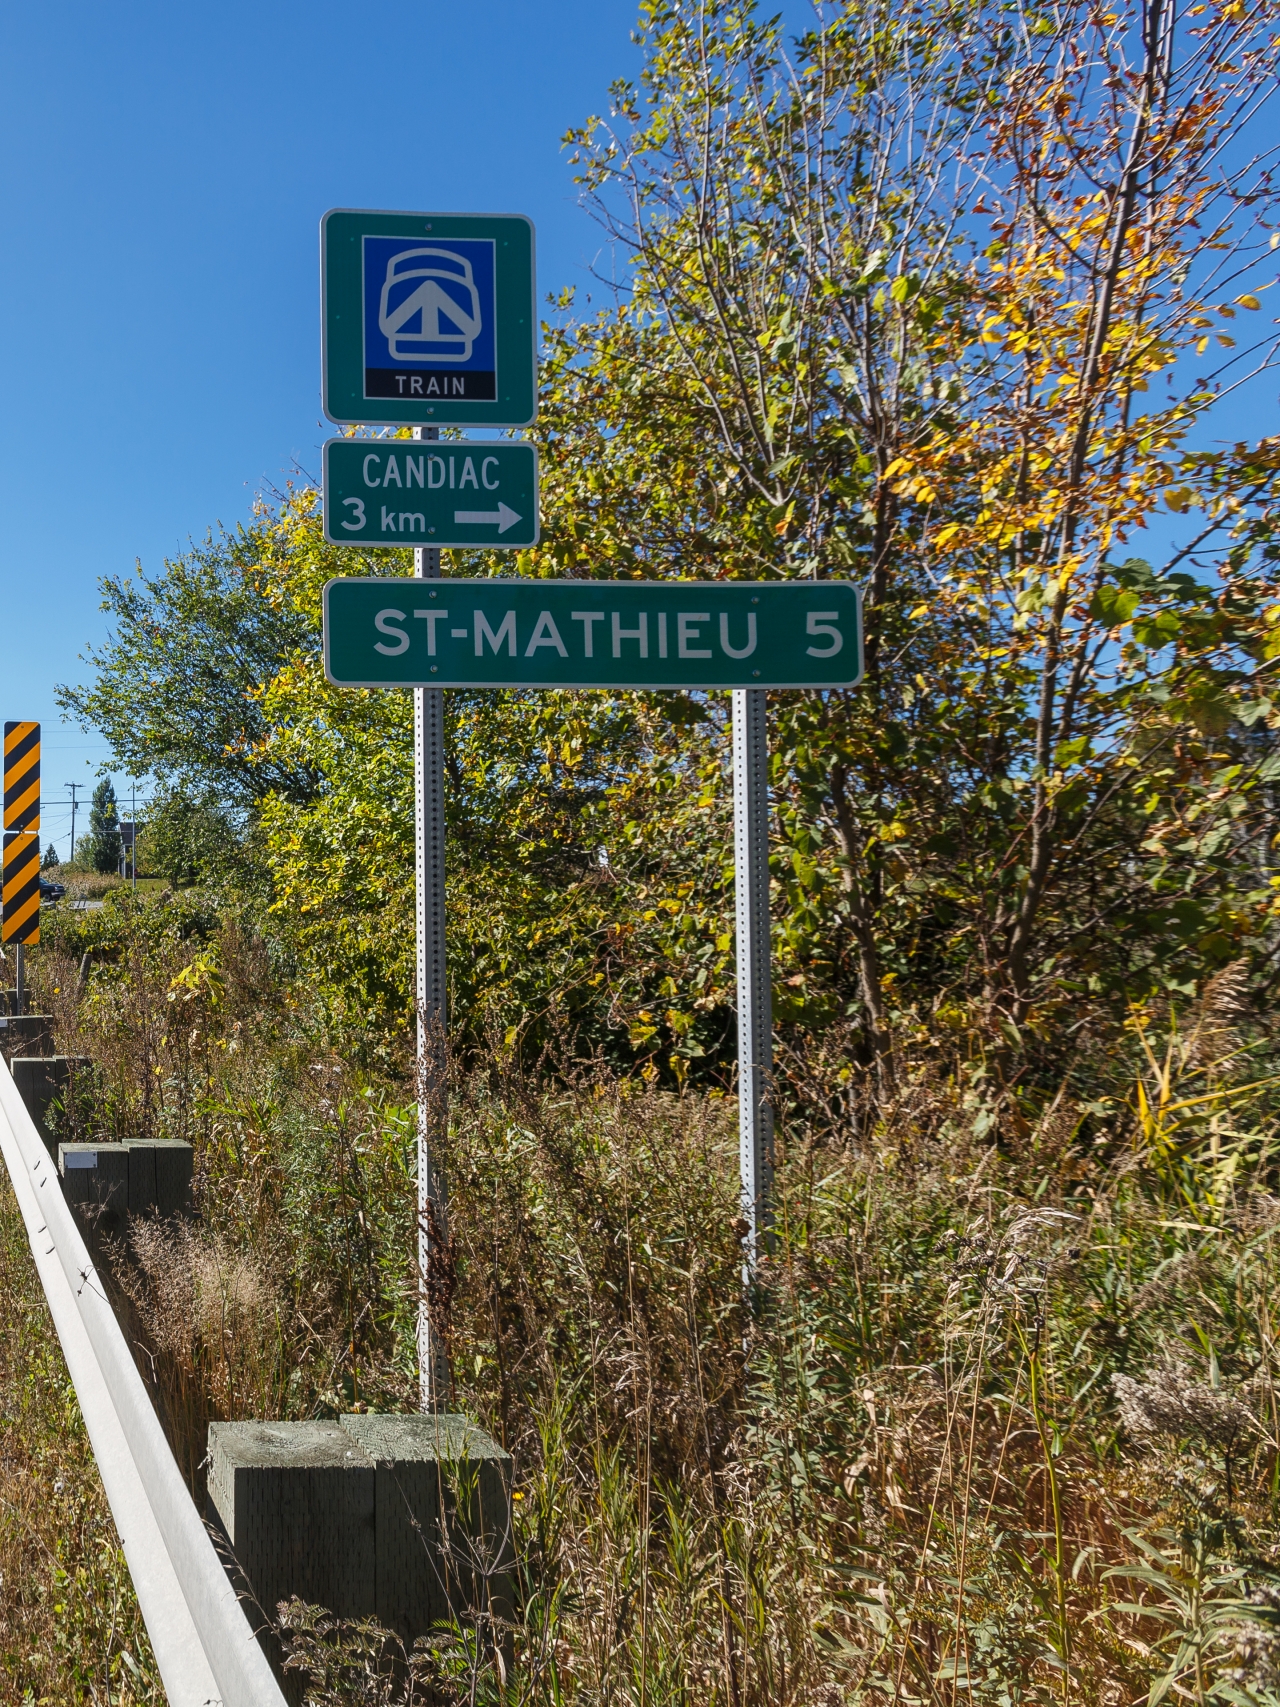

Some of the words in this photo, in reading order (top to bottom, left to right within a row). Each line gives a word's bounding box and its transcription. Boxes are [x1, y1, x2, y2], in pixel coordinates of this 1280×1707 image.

[395, 376, 465, 395] TRAIN
[363, 454, 500, 490] CANDIAC
[341, 497, 367, 531] 3
[381, 505, 426, 532] km
[373, 608, 758, 659] ST-MATHIEU
[805, 611, 844, 658] 5
